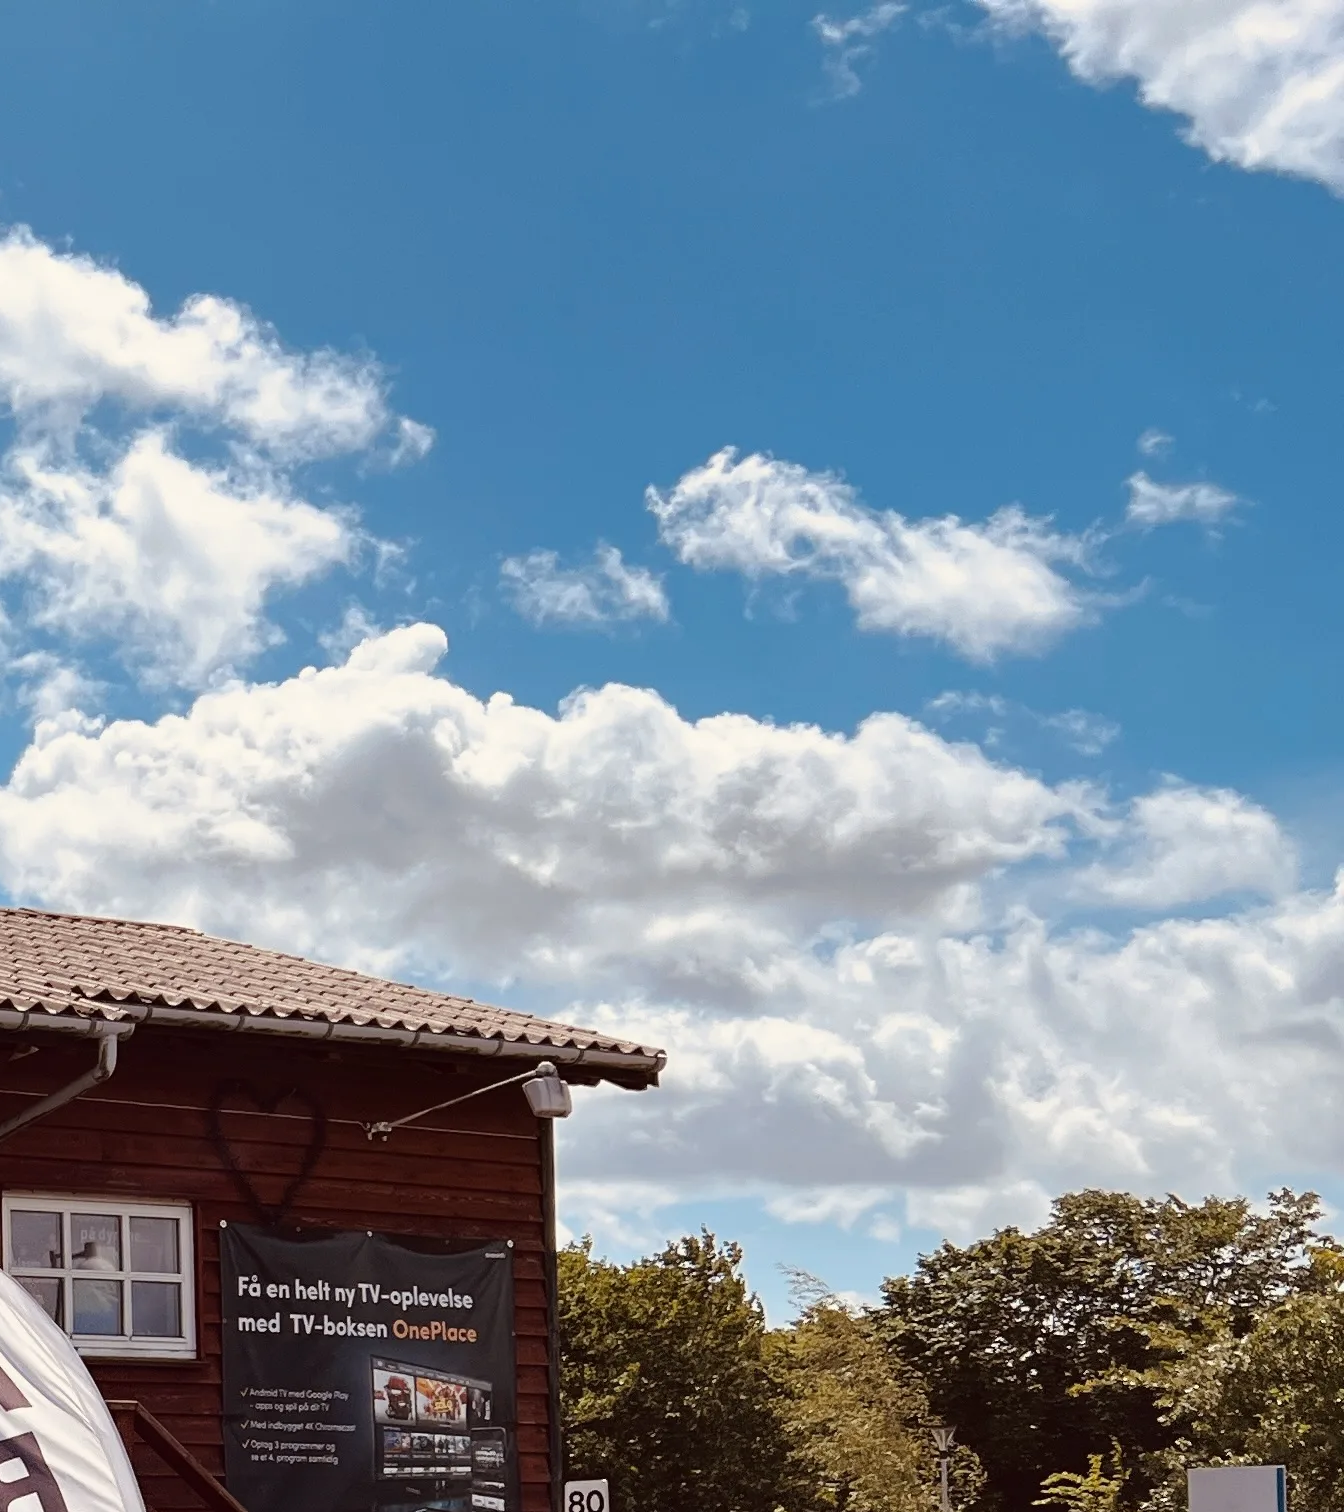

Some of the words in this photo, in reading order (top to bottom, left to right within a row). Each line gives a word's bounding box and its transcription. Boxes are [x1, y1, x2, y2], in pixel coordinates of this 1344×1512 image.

[238, 1275, 261, 1298] Få
[266, 1282, 290, 1300] en
[295, 1279, 331, 1302] helt
[335, 1288, 356, 1310] ny
[358, 1283, 474, 1311] TV-oplevelse
[238, 1312, 281, 1334] med
[290, 1314, 389, 1340] TV-boksen
[392, 1319, 478, 1343] OnePlace
[249, 1388, 278, 1398] Android
[278, 1389, 287, 1398] TV
[288, 1389, 305, 1399] med
[306, 1390, 332, 1401] Google
[333, 1390, 350, 1401] Play
[254, 1403, 273, 1411] apps
[274, 1404, 284, 1412] og
[285, 1402, 297, 1412] spil
[298, 1402, 309, 1413] på
[320, 1403, 330, 1412] TV
[249, 1420, 266, 1429] Med
[267, 1422, 304, 1432] indbygget
[280, 1442, 325, 1452] programmer
[325, 1444, 336, 1452] og
[276, 1455, 307, 1464] program
[308, 1455, 339, 1466] samtidig
